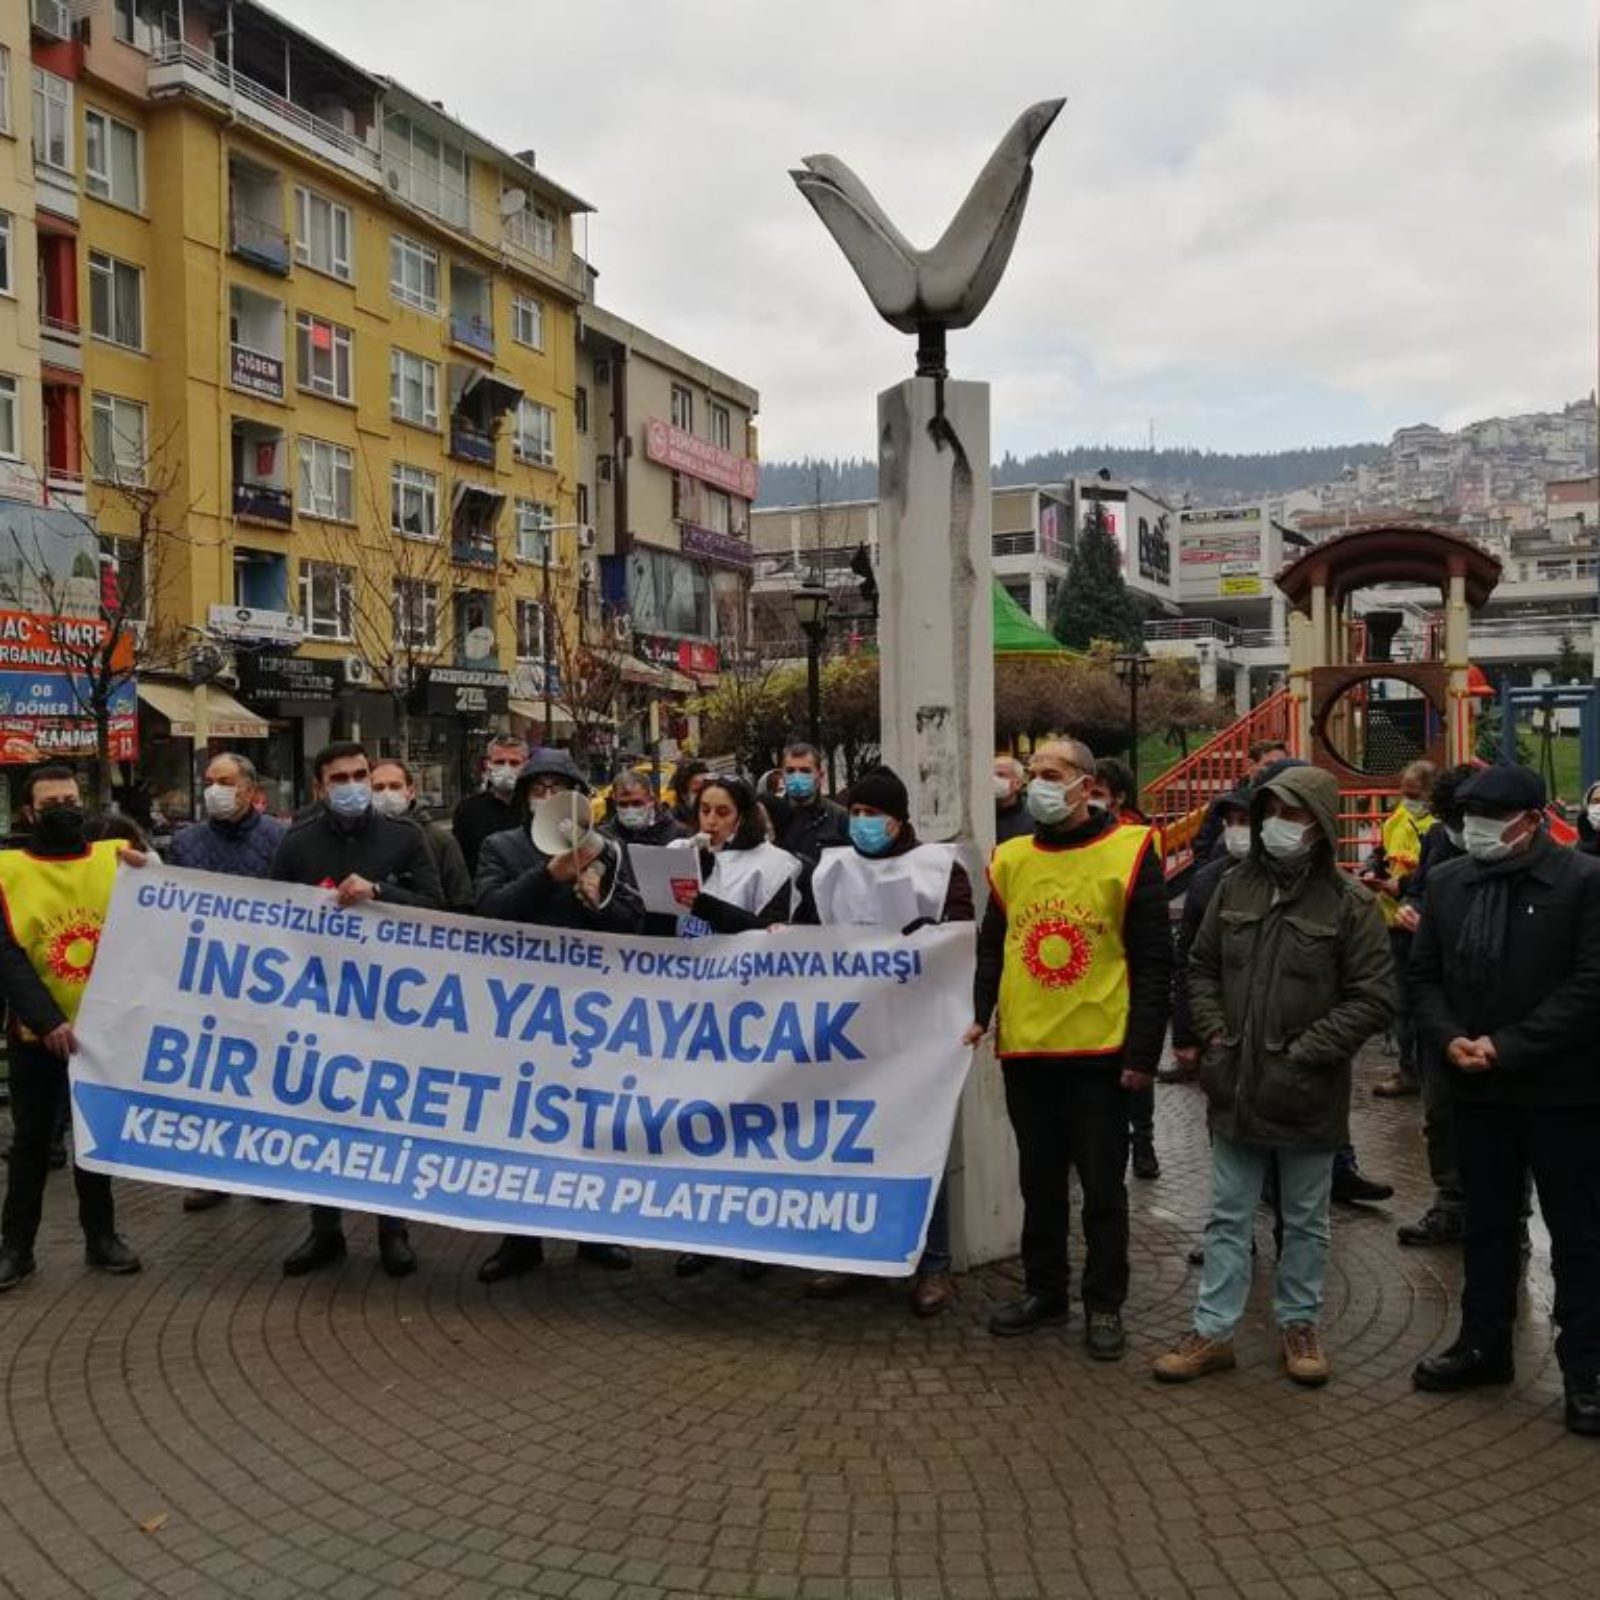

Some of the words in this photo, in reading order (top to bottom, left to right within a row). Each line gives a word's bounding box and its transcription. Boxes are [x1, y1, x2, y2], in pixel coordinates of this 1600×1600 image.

[15, 699, 69, 715] DÖNER
[137, 883, 367, 944] GÜVENCESİZLİĞE,
[377, 919, 610, 974] GELECEKSİZLİĞE,
[619, 949, 827, 985] YOKSULLAŞMAYA
[834, 948, 922, 983] KARŞI
[178, 919, 470, 1033] İNSANCA
[487, 979, 866, 1067] YAŞAYACAK
[142, 1015, 258, 1097] BİR
[272, 1030, 502, 1133] ÜCRET
[508, 1061, 876, 1164] İSTİYORUZ
[121, 1106, 234, 1158] KESK
[234, 1125, 414, 1185] KOCAELİ
[413, 1153, 601, 1211] ŞUBELER
[611, 1177, 877, 1234] PLATFORMU
